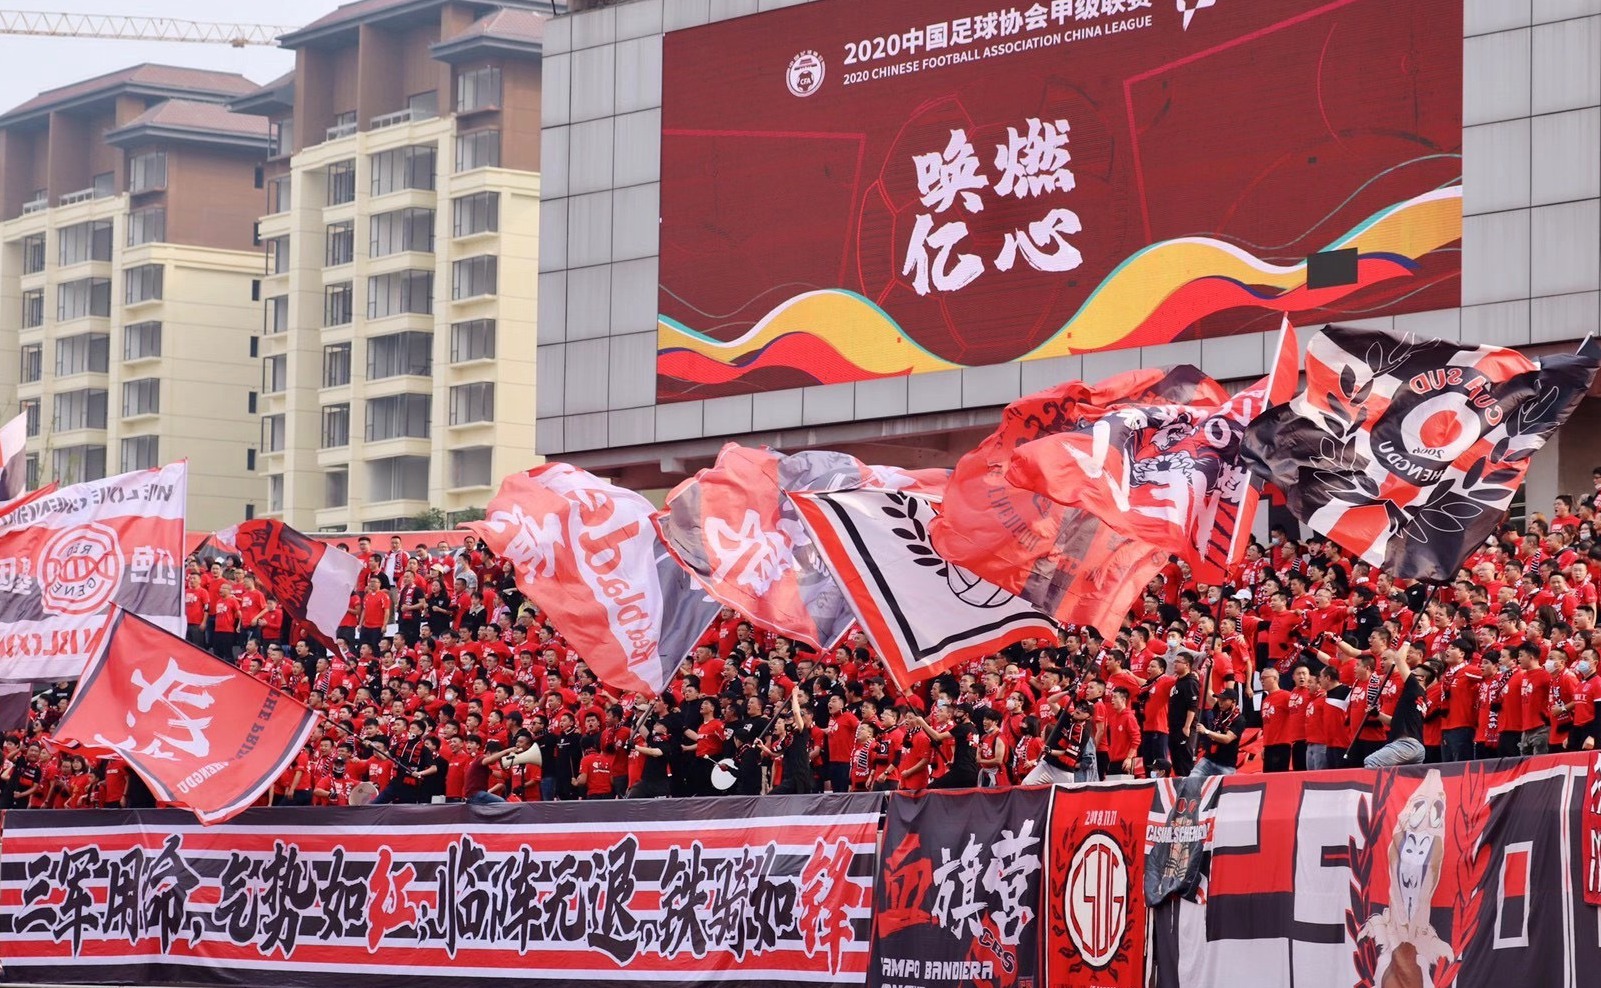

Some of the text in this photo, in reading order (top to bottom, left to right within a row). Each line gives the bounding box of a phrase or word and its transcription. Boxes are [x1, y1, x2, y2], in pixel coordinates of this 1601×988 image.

[843, 0, 1152, 65] 2020中国足球协会甲级联
[843, 15, 1152, 85] 2020 CHINESE FOOTBALL ASSOCIATION CHINA LEAGUE
[913, 117, 1076, 215] 唤燃
[903, 208, 1082, 297] 亿心
[877, 818, 1042, 946] 血旗营
[880, 957, 993, 980] AMPO BANDIERA
